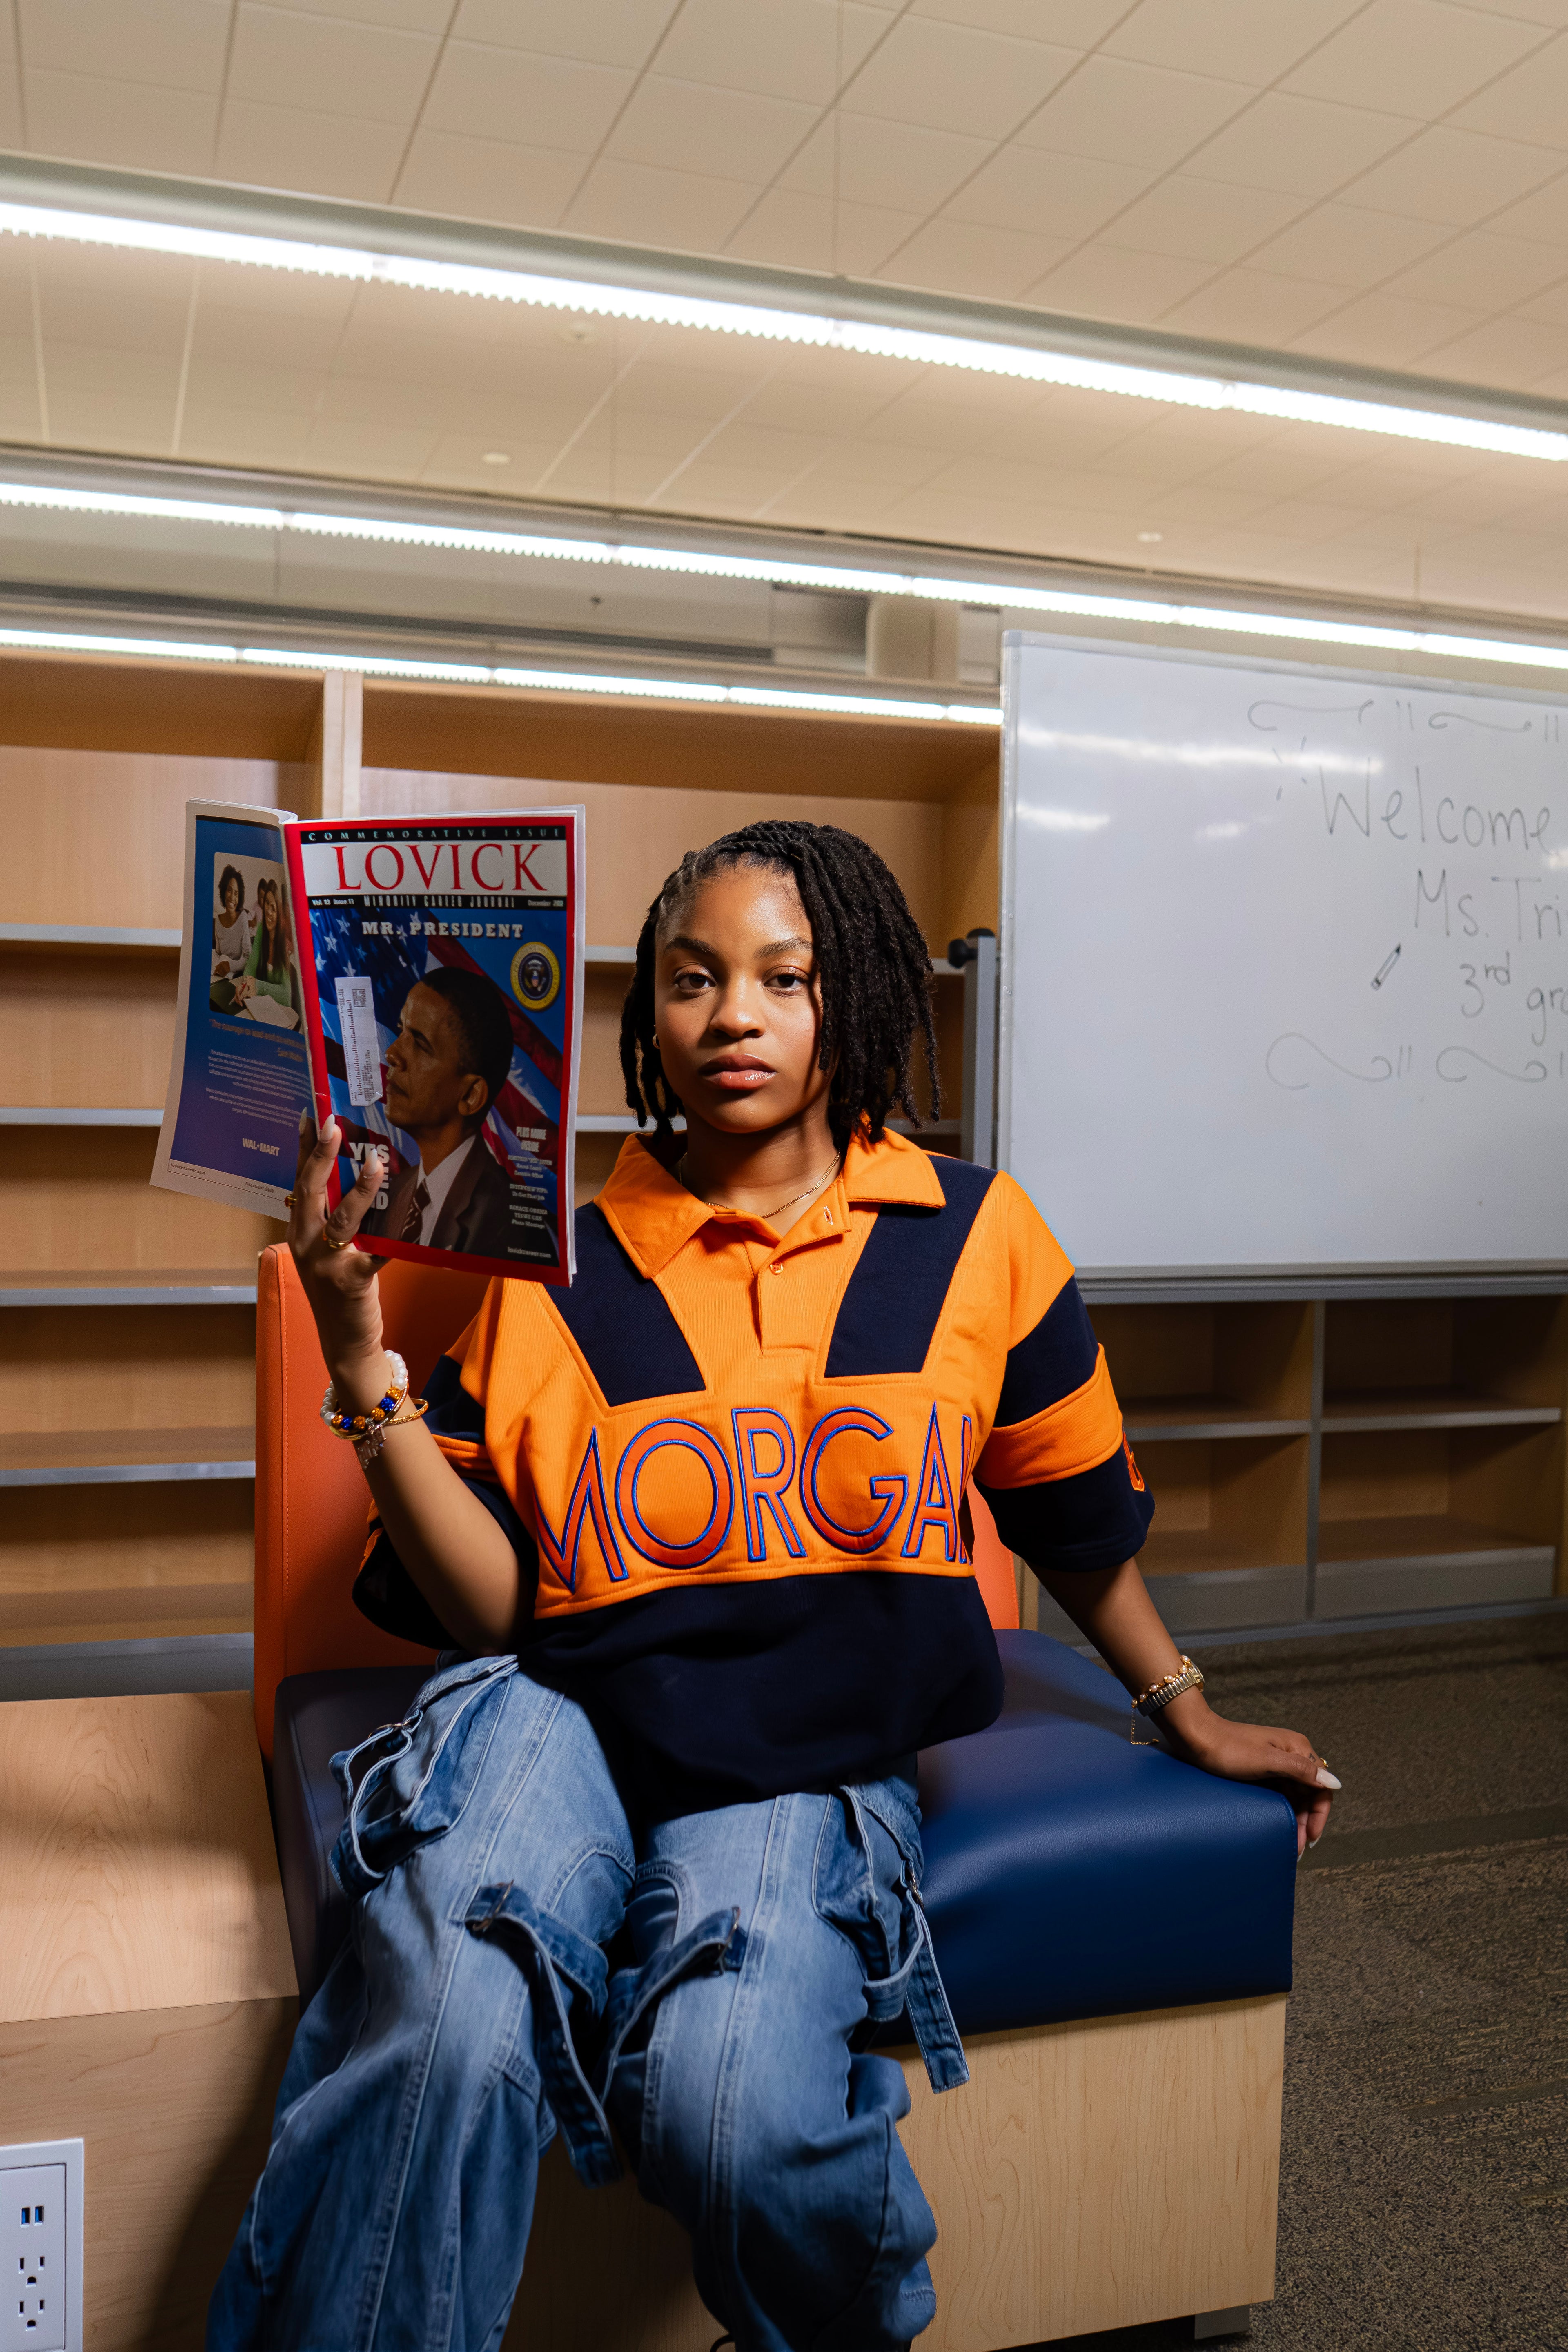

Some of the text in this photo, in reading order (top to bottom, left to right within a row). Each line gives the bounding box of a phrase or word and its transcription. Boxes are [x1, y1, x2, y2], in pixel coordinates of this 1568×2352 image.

[1319, 757, 1561, 857] Welcome
[308, 829, 559, 841] COMMEMORATIVE ISSUE
[330, 843, 548, 891] LOVICK
[362, 922, 523, 938] MR. PRESIDENT
[1459, 949, 1511, 1018] 3rd
